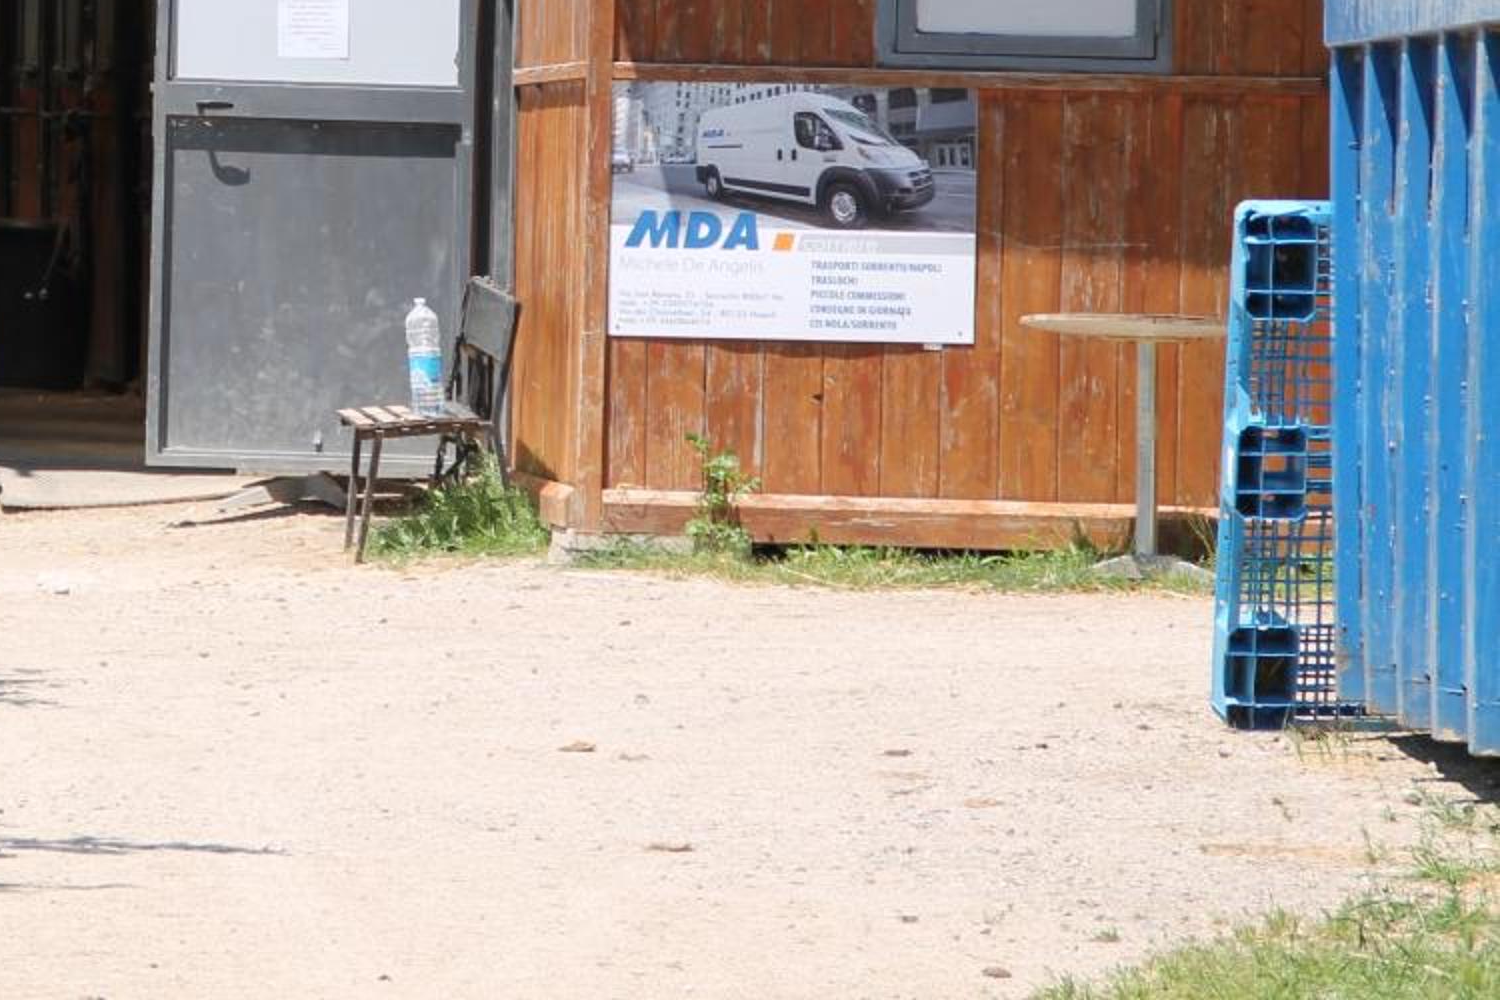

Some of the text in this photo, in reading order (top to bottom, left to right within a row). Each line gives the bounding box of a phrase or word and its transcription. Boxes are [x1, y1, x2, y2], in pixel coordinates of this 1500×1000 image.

[625, 209, 759, 250] MDA
[619, 256, 764, 276] Michele De Angelis
[811, 261, 858, 271] TRASPORTI
[811, 275, 858, 285] TRASLOCHI
[810, 289, 907, 301] PICCOLE COMMISSIONI
[810, 305, 912, 317] CONSEGNE IN GIORNATA
